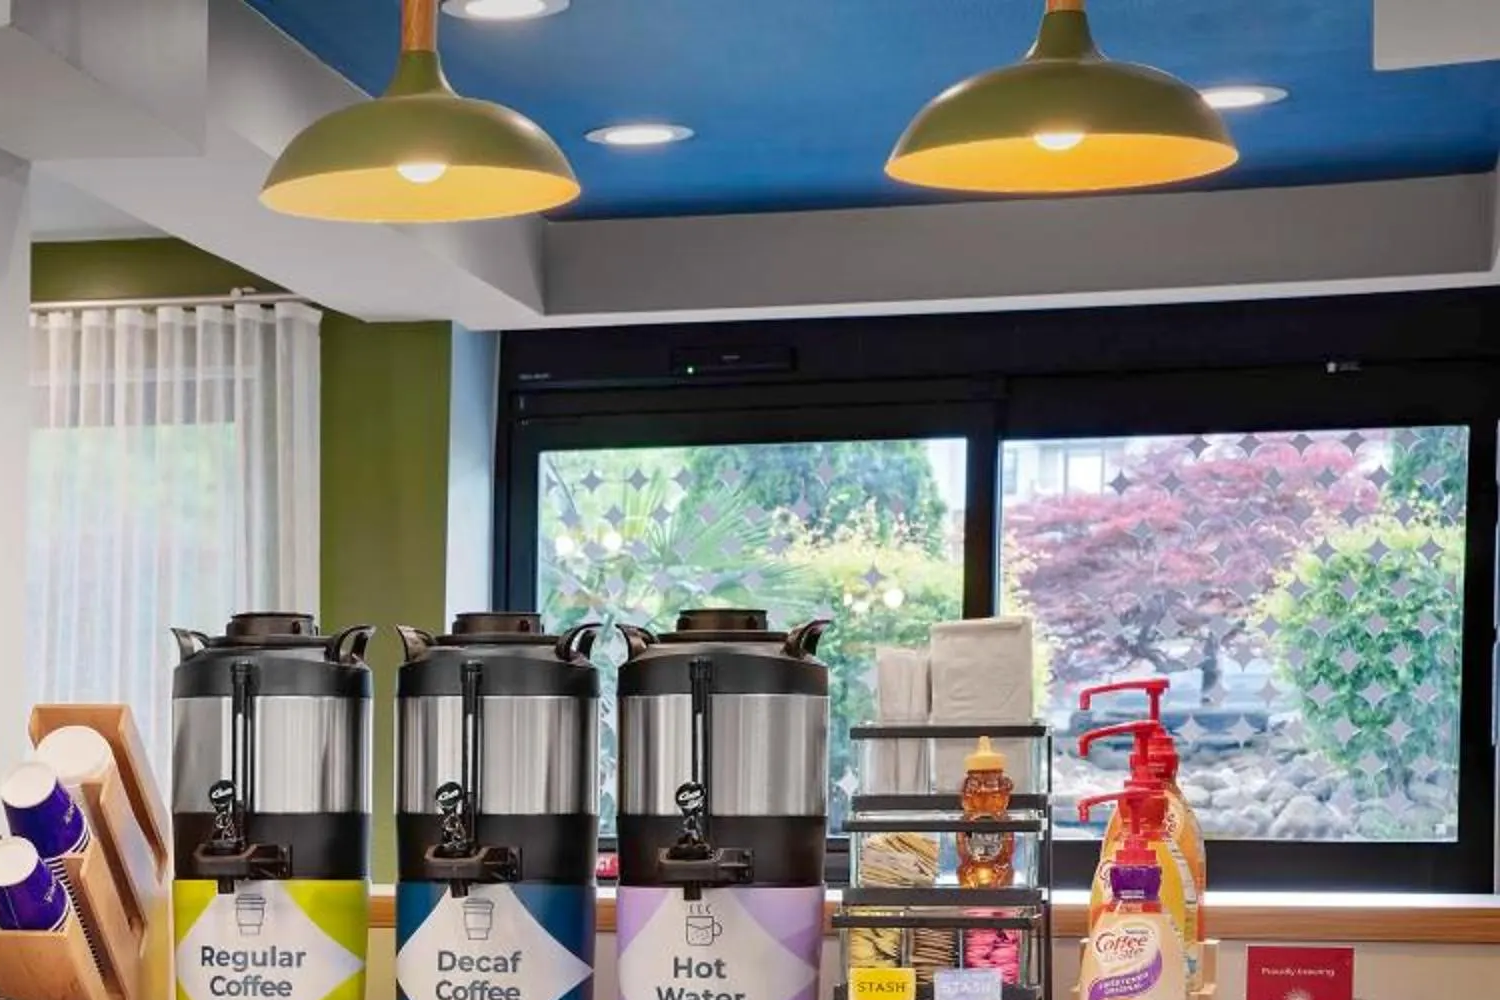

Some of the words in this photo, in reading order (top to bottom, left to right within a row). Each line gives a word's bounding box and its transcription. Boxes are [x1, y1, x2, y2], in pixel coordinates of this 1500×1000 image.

[200, 945, 307, 973] Regular
[437, 949, 522, 973] Decaf
[673, 956, 727, 979] Hot
[209, 974, 293, 997] Coffee
[857, 980, 906, 993] STASH
[940, 979, 991, 993] STASH
